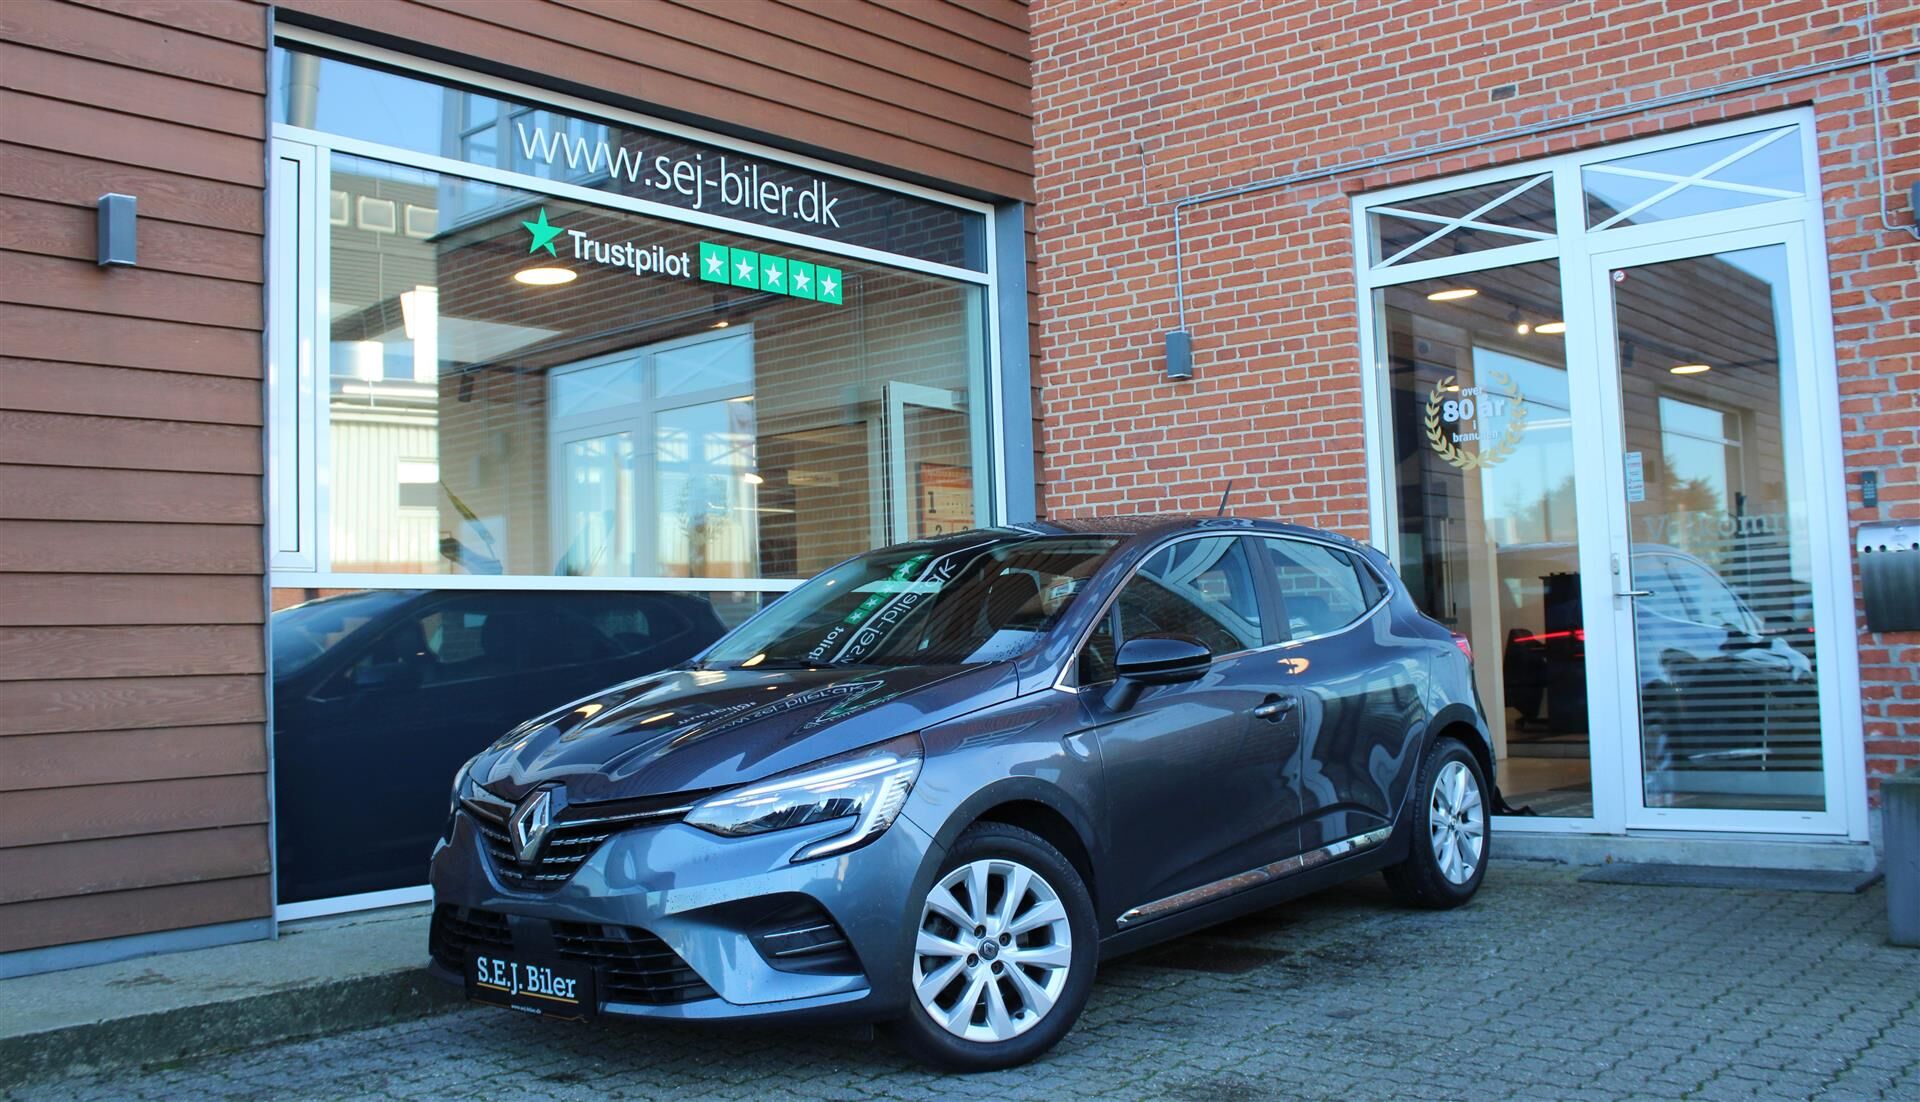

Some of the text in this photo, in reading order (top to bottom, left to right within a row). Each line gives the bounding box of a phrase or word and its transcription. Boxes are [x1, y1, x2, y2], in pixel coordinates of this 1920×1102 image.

[517, 122, 840, 228] www.sej-biler.dk
[568, 229, 690, 278] Trustpilot
[1443, 393, 1504, 421] 80 år
[1452, 430, 1498, 443] brancen
[477, 956, 577, 998] S.E.J. Biler
